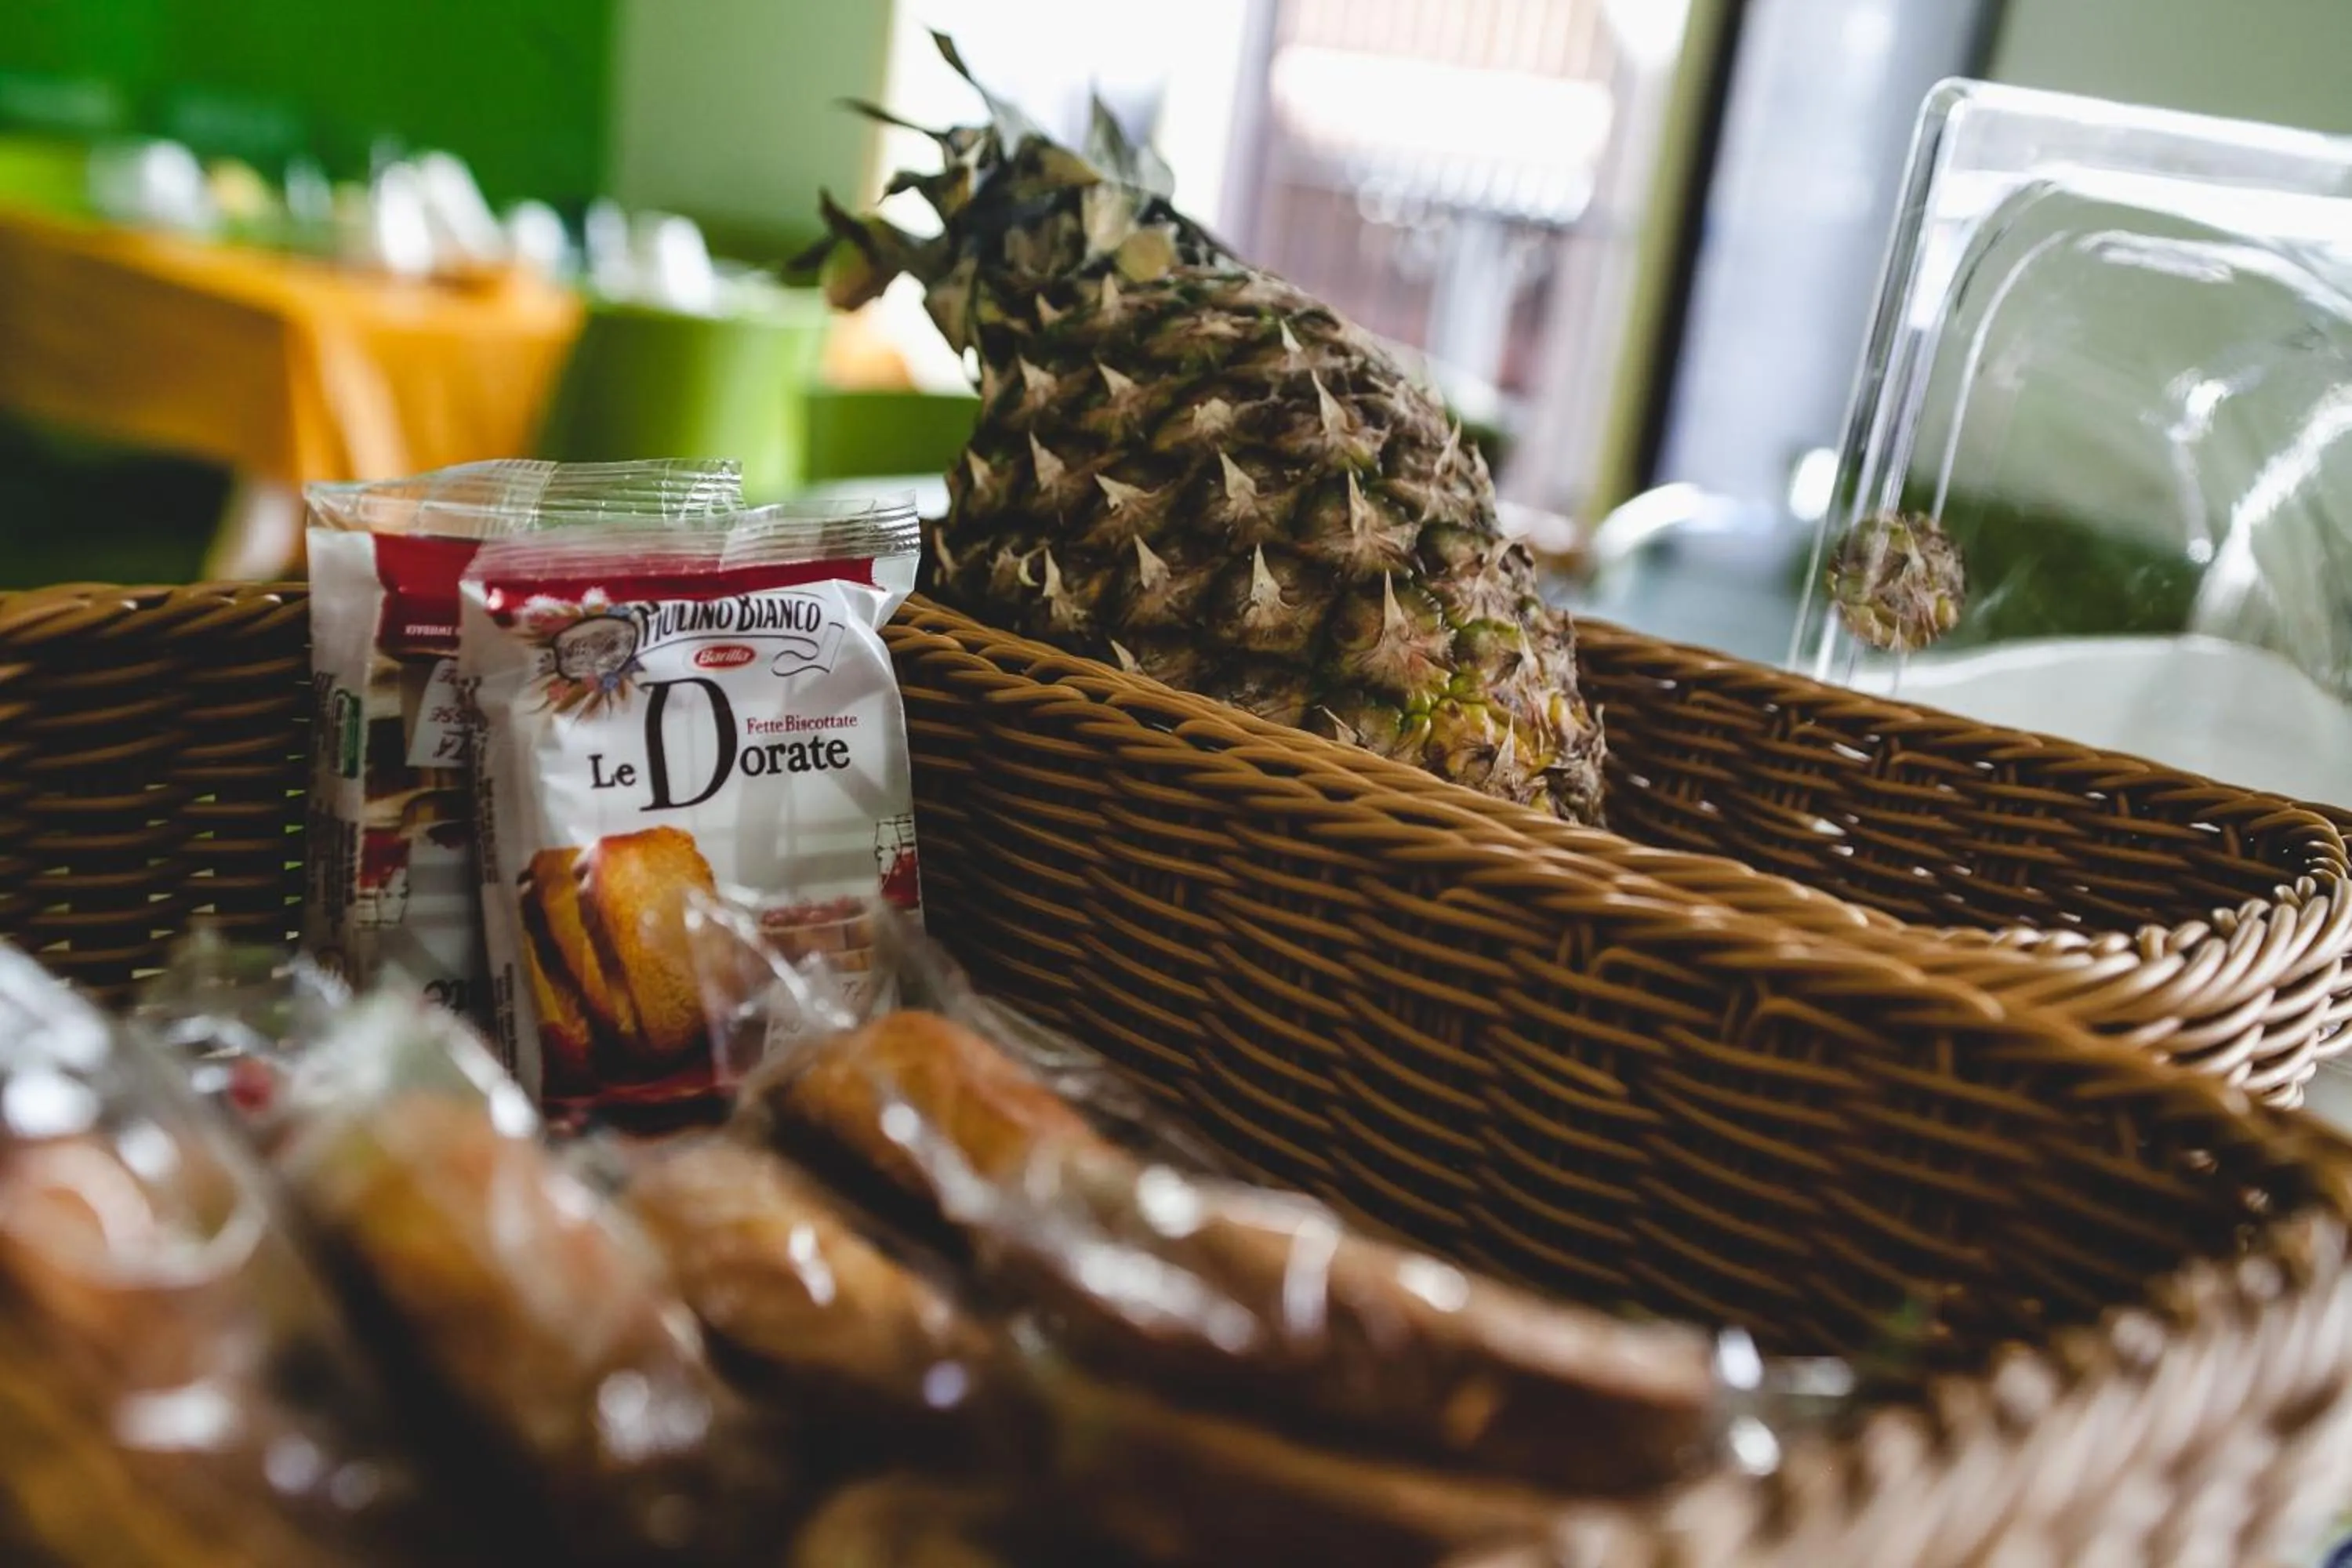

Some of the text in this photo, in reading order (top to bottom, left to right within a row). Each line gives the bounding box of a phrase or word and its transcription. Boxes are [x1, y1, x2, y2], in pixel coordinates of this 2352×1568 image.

[735, 595, 821, 633] BIANCO
[699, 648, 751, 666] Barilla
[746, 713, 858, 735] Fette Biscottate
[587, 753, 637, 789] Le
[639, 677, 851, 811] Dorate
